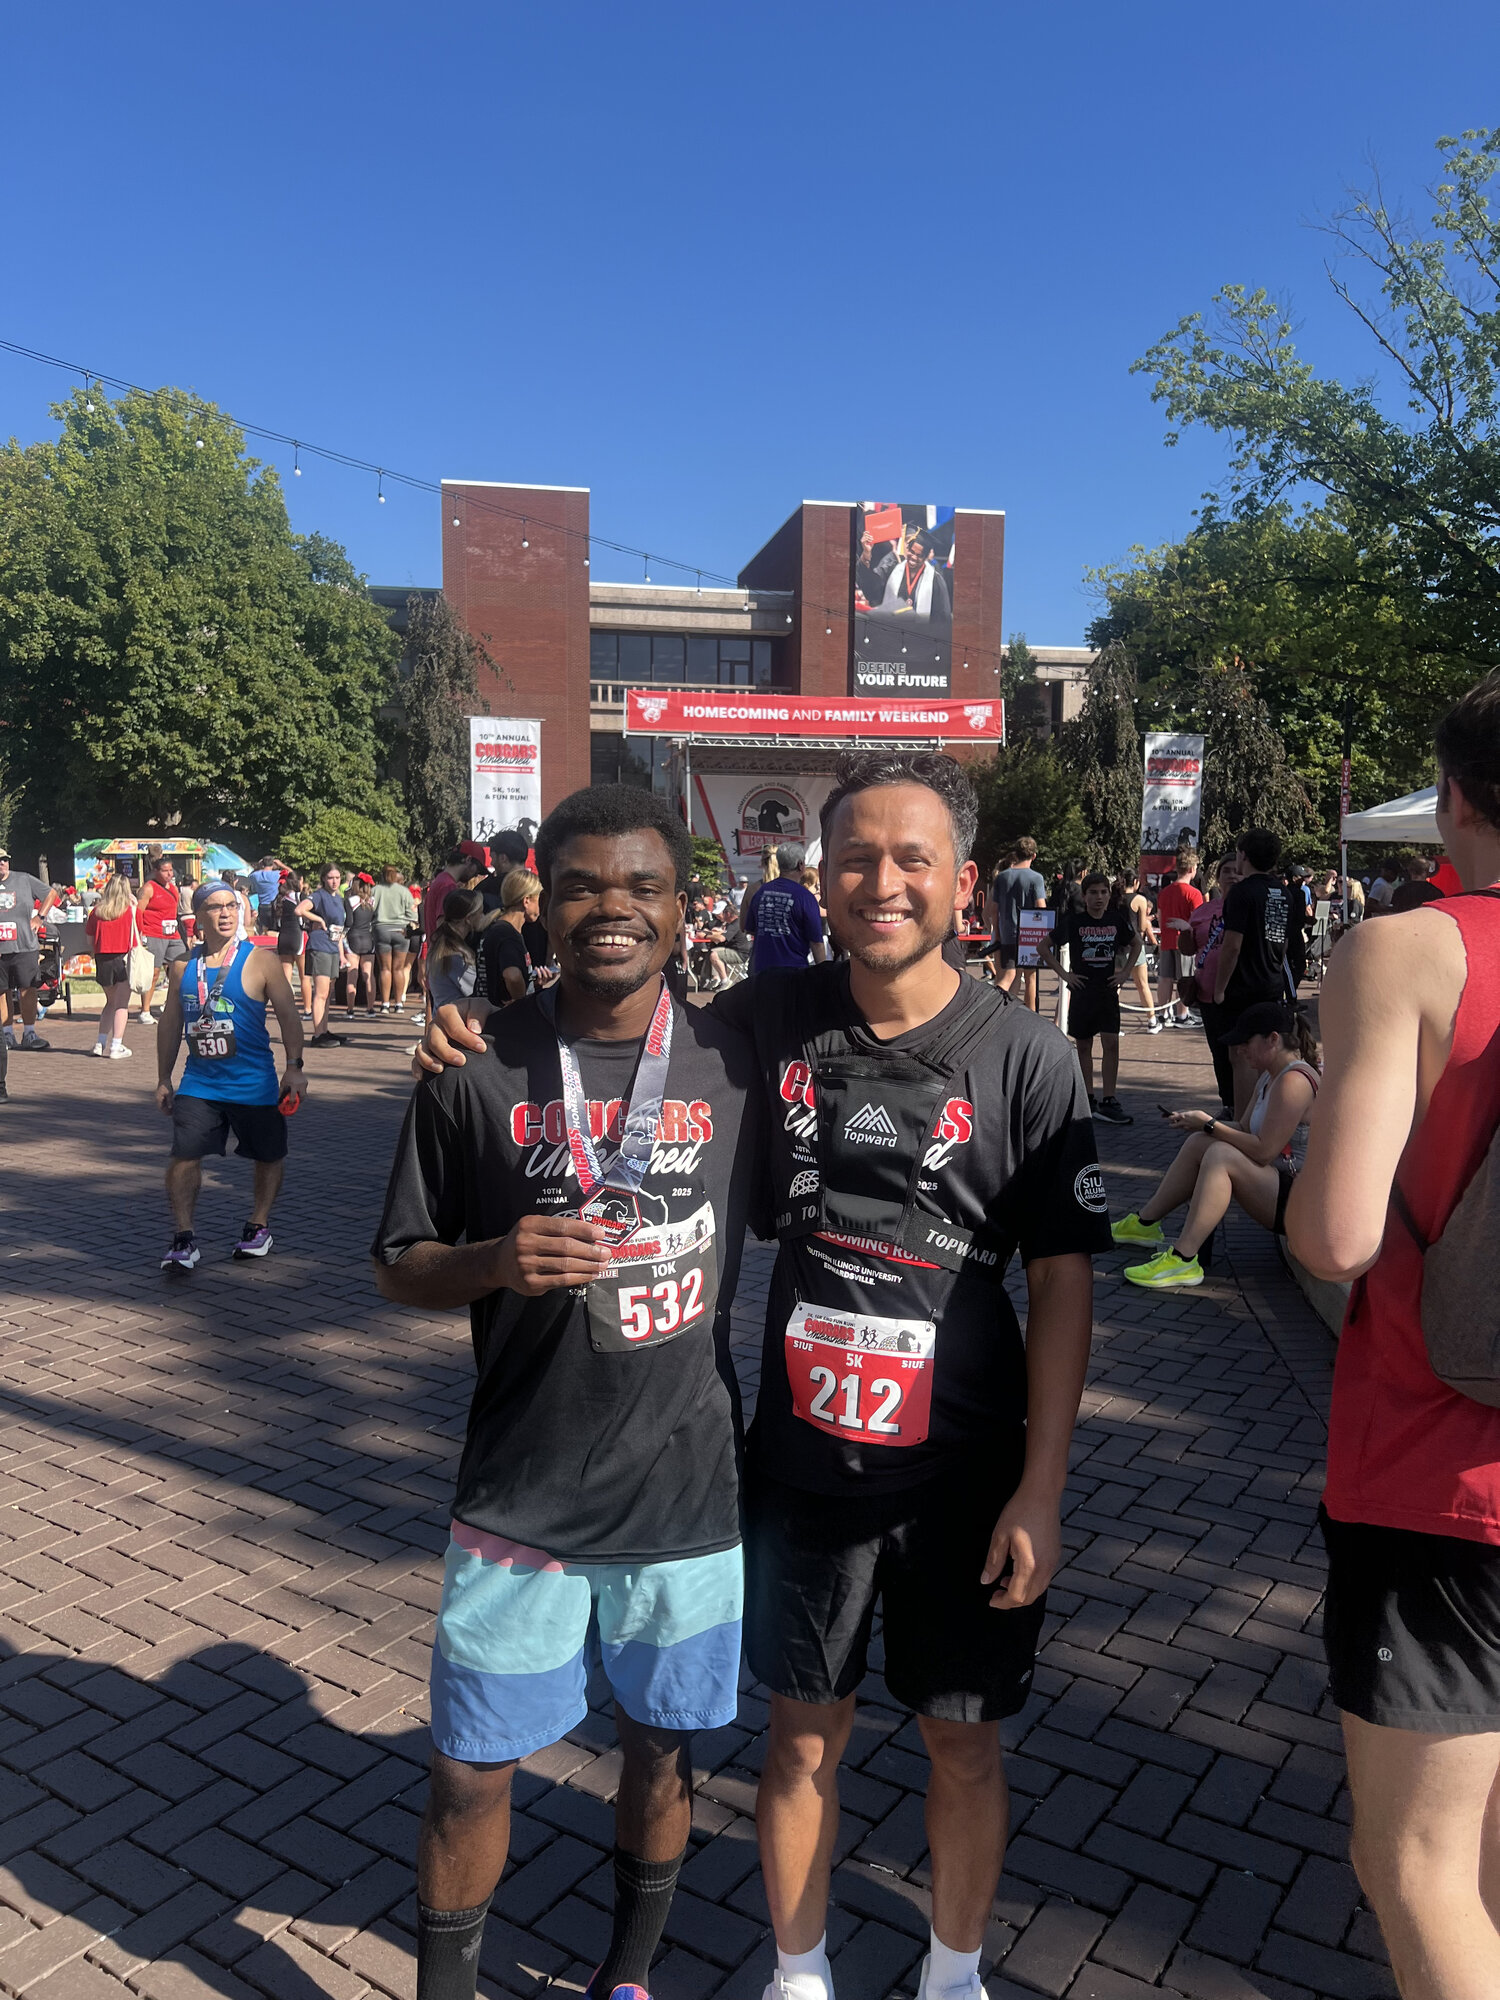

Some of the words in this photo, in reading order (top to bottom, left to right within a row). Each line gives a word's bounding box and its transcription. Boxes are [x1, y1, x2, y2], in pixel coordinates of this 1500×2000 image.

[857, 661, 906, 674] DEFINE
[857, 674, 895, 686] YOUR
[897, 675, 948, 687] FUTURE
[683, 706, 789, 720] HOMECOMING
[791, 709, 821, 721] AND
[824, 710, 876, 722] FAMILY
[879, 711, 949, 723] WEEKEND
[496, 734, 531, 742] ANNUAL
[475, 742, 537, 760] COUGARS
[1147, 757, 1199, 773] COUGARS
[1146, 873, 1164, 888] SI
[646, 988, 671, 1057] COUGARS
[197, 1037, 228, 1056] 530
[567, 1056, 581, 1129] HOMECOMING
[843, 1127, 898, 1148] Topward
[790, 1152, 818, 1164] NNUAL
[917, 1180, 938, 1191] 2025
[1082, 1176, 1103, 1189] SIU
[671, 1187, 692, 1197] 2025
[536, 1196, 569, 1205] ANNUAL
[592, 1216, 627, 1231] COUGARS
[925, 1228, 998, 1266] TOPWARD
[651, 1260, 677, 1279] 10K
[832, 1259, 861, 1273] ILLINOIS
[861, 1267, 902, 1283] UNIVERSITY
[618, 1267, 705, 1342] 532
[793, 1340, 814, 1352] SIUE
[845, 1352, 864, 1369] 5K
[901, 1359, 925, 1369] SIUE
[809, 1366, 902, 1434] 212
